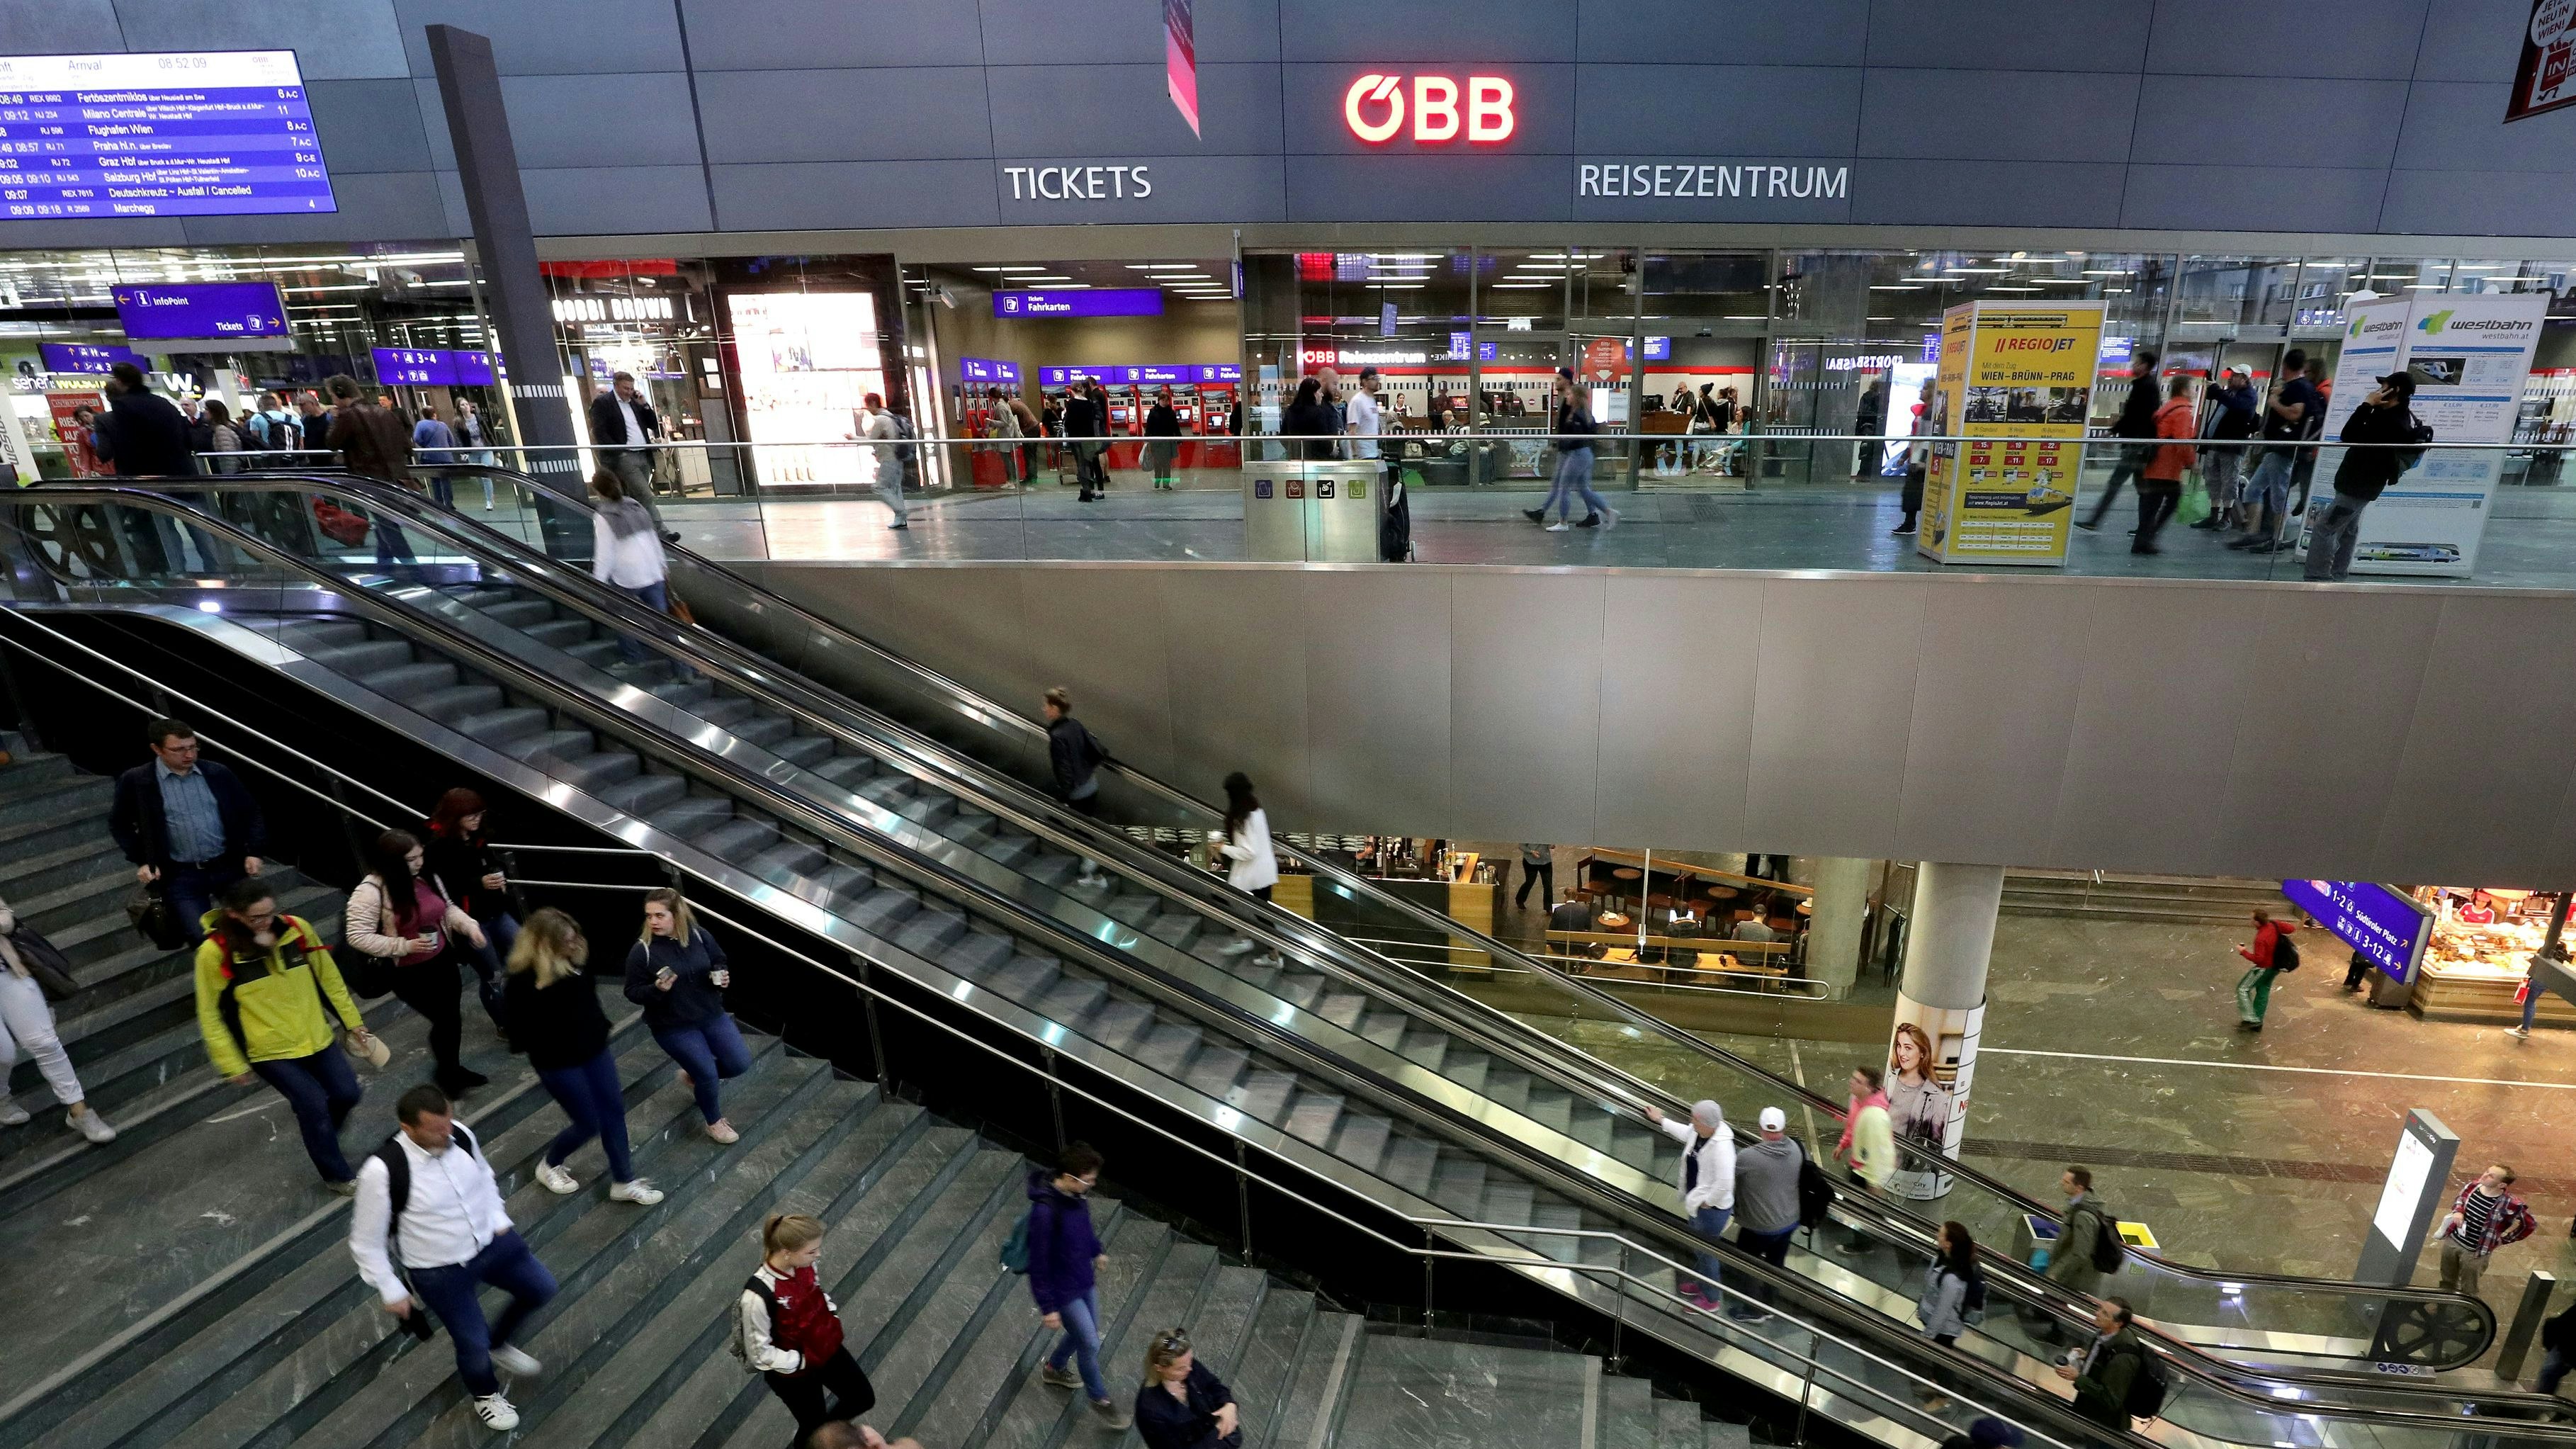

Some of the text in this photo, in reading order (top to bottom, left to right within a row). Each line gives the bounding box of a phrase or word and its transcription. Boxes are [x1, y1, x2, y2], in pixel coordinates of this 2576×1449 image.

[2538, 4, 2570, 28] NEU IN
[2538, 19, 2565, 40] WIEN!
[278, 89, 285, 98] 6
[286, 89, 298, 98] A-C
[4, 111, 29, 120] 09:12
[82, 108, 111, 119] Milano
[111, 108, 147, 118] Centrale
[278, 105, 288, 115] 11
[1345, 74, 1514, 142] ÖBB
[88, 125, 130, 137] Flughafen
[130, 124, 154, 135] Wien
[287, 120, 294, 130] 8
[295, 123, 307, 131] A-C
[16, 143, 38, 152] 08:57
[93, 141, 119, 151] Praha
[291, 137, 297, 146] 7
[98, 157, 120, 167] Graz
[120, 156, 136, 167] Hbf
[295, 153, 303, 163] 9
[0, 174, 24, 184] 09:05
[27, 174, 51, 184] 09:10
[104, 172, 141, 184] Salzburg
[142, 171, 157, 181] Hbf
[295, 168, 307, 179] 10
[307, 169, 320, 178] A-C
[1004, 166, 1152, 200] TICKETS
[1580, 164, 1848, 198] REISEZENTRUM
[5, 190, 28, 200] 09:07
[108, 187, 169, 198] Deutschkreutz
[177, 186, 205, 196] Ausfall
[211, 185, 252, 196] Cancelled
[10, 205, 35, 215] 09:09
[38, 205, 62, 215] 09:18
[113, 203, 156, 214] Marchegg
[310, 199, 315, 208] 4
[153, 296, 189, 306] InfoPoint
[1028, 303, 1070, 312] Fahrkarten
[552, 297, 673, 322] BOBBI BROWN
[215, 322, 244, 332] Tickets
[2364, 321, 2403, 333] westbahn
[2451, 320, 2533, 330] westbahn
[2008, 339, 2076, 353] REGIOJET
[417, 352, 437, 364] 3-4
[1338, 351, 1426, 364] Reisezentrum
[1982, 370, 2075, 381] WIEN BRÜNN PRAG
[2332, 890, 2346, 908] 1-2
[2355, 910, 2398, 946] Südtiroler Platz
[2362, 935, 2384, 959] 3-12
